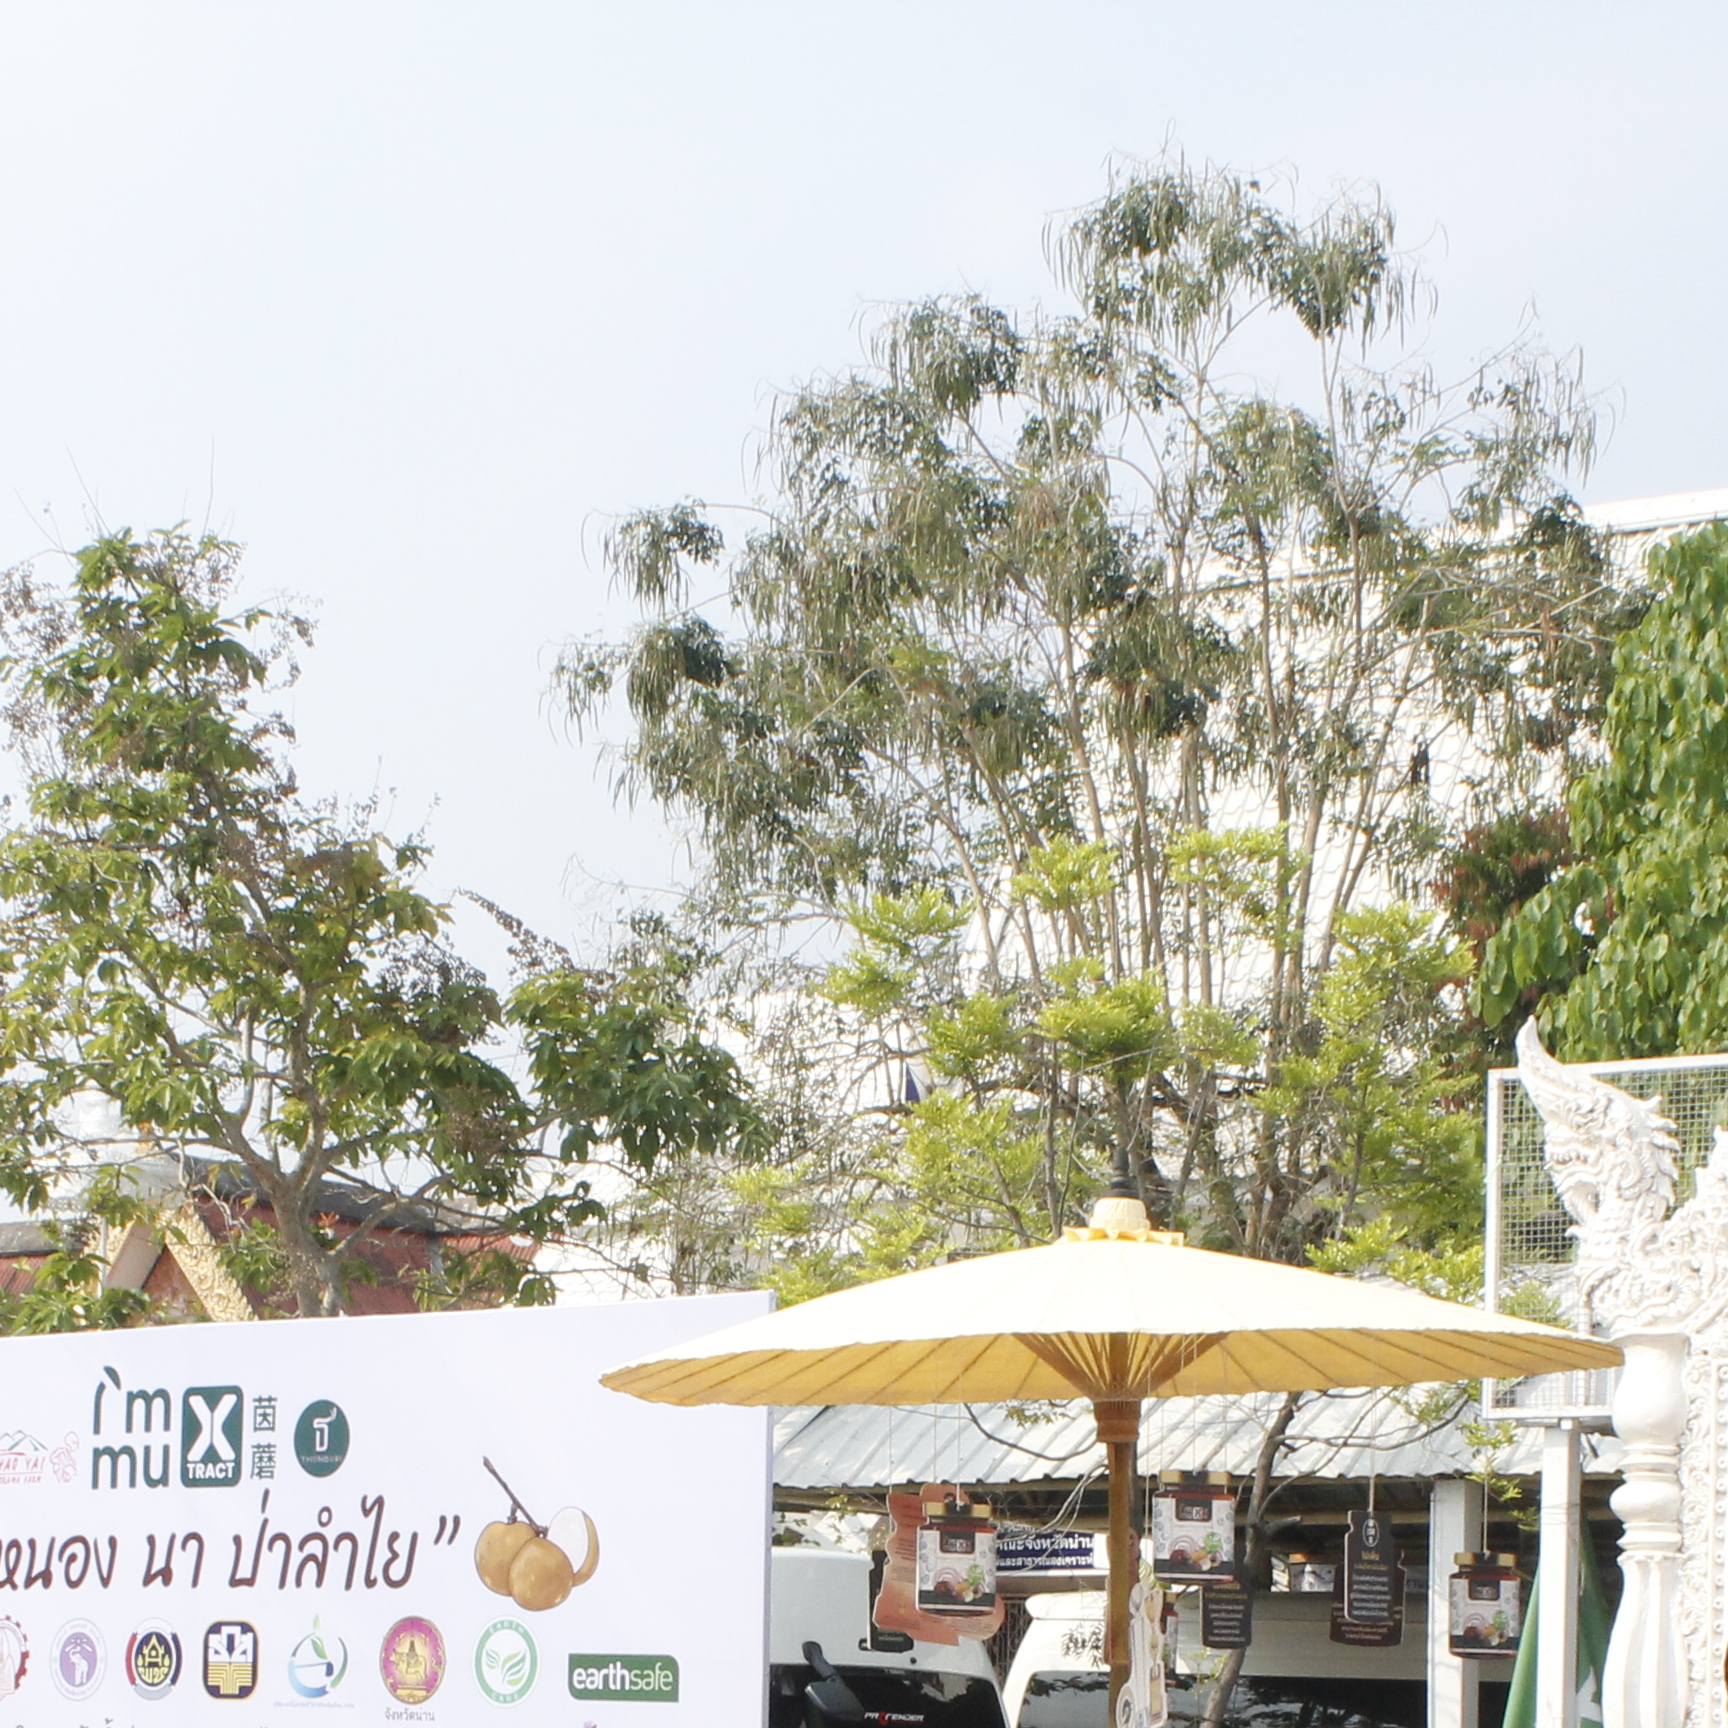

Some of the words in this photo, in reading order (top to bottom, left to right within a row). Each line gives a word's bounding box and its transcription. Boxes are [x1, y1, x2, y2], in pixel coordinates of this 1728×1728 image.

[24, 1456, 46, 1471] YAI
[92, 1444, 170, 1489] mu
[186, 1462, 235, 1480] TRACT
[142, 1531, 205, 1589] นา
[573, 1660, 674, 1694] earthsafe
